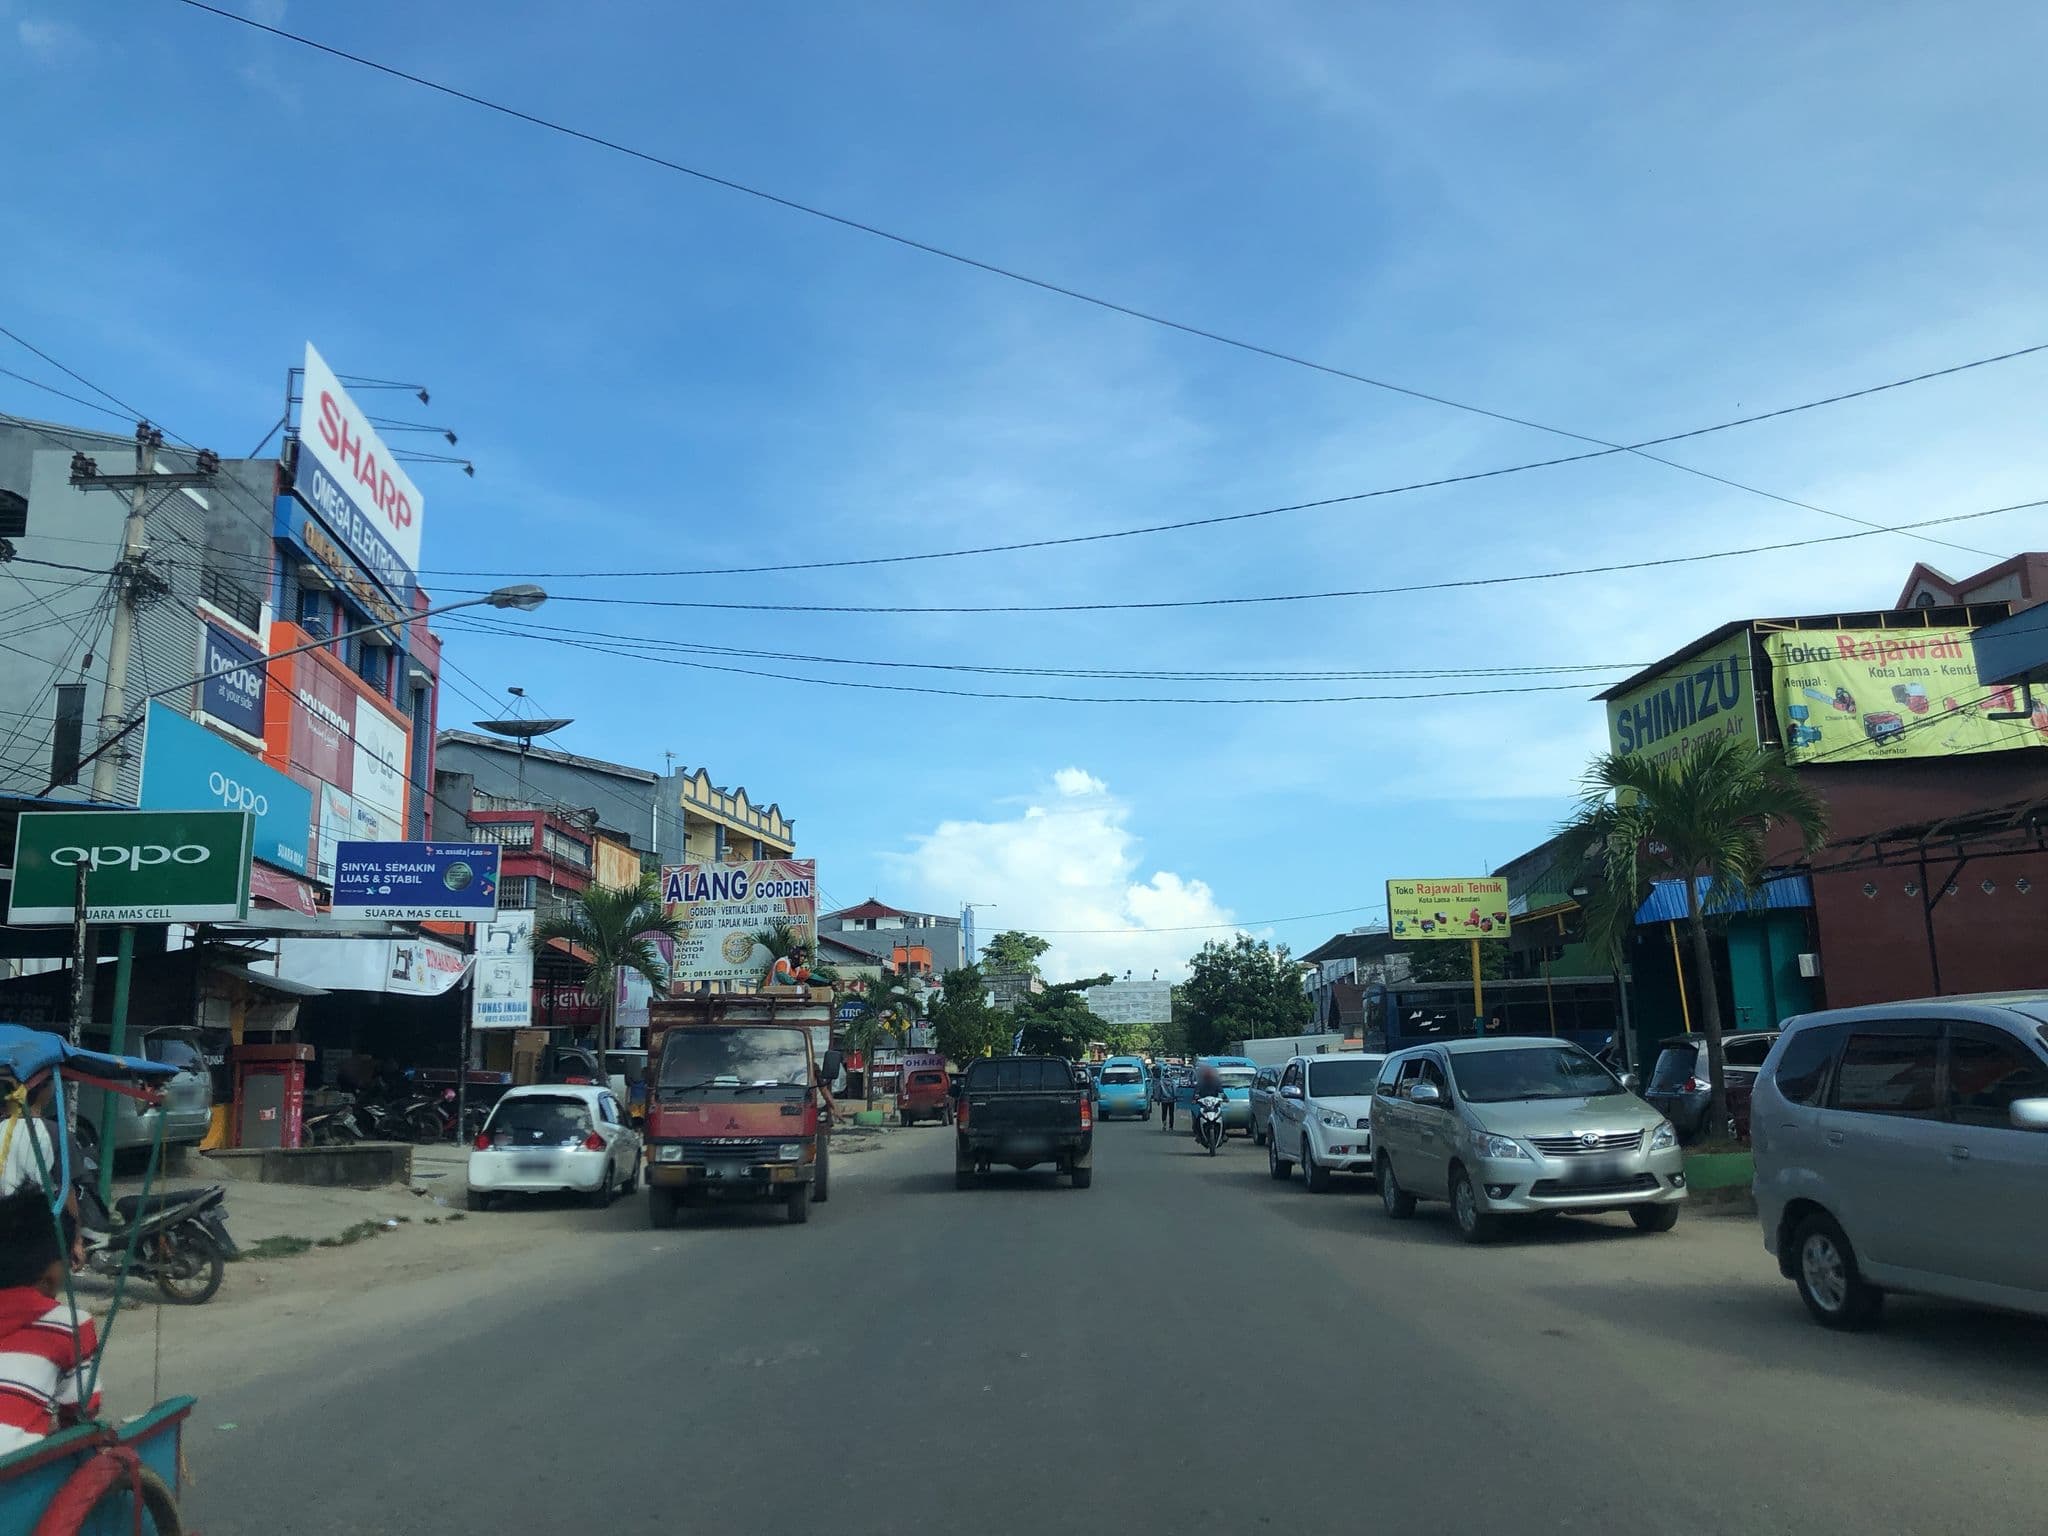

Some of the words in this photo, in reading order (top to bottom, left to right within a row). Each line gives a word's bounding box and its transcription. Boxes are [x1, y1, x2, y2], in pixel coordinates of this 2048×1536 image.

[318, 390, 412, 530] SHARP
[312, 469, 350, 536] OMEGA
[1781, 643, 1831, 663] Toko
[1836, 632, 1962, 667] Rajawali
[210, 646, 262, 699] brother
[1868, 667, 1895, 678] Kota
[1898, 665, 1930, 677] Lama
[218, 684, 226, 697] at
[227, 688, 240, 704] your
[240, 695, 253, 711] side
[1617, 653, 1740, 755] SHIMIZU
[300, 689, 350, 736] POLYTRON
[1726, 715, 1743, 738] Air
[381, 746, 394, 780] LG
[1869, 748, 1907, 756] Generator
[209, 772, 268, 816] oppo
[50, 844, 210, 872] oppo
[341, 862, 382, 872] SINYAL
[384, 863, 436, 873] SEMAKIN
[340, 874, 370, 883] LUAS
[372, 875, 381, 884] &
[383, 875, 422, 884] STABIL
[666, 870, 748, 902] ALANG
[755, 880, 809, 899] GORDEN
[1395, 886, 1414, 895] Toko
[1416, 883, 1464, 896] Rajawali
[1467, 882, 1502, 893] Tehnik
[86, 909, 115, 920] UARA
[118, 908, 144, 919] MAS
[146, 908, 172, 919] CELL
[365, 909, 403, 918] SUARA
[406, 909, 431, 918] MAS
[434, 909, 461, 918] CELL
[690, 906, 716, 916] GORDEN
[721, 905, 748, 915] VERTIKAL
[750, 905, 768, 914] BLIND
[773, 903, 786, 912] RELL
[695, 920, 713, 929] KURSI
[718, 918, 740, 928] TAPLAK
[742, 918, 758, 927] MEJA
[798, 915, 809, 924] DLL
[477, 1002, 502, 1013] TUNAS
